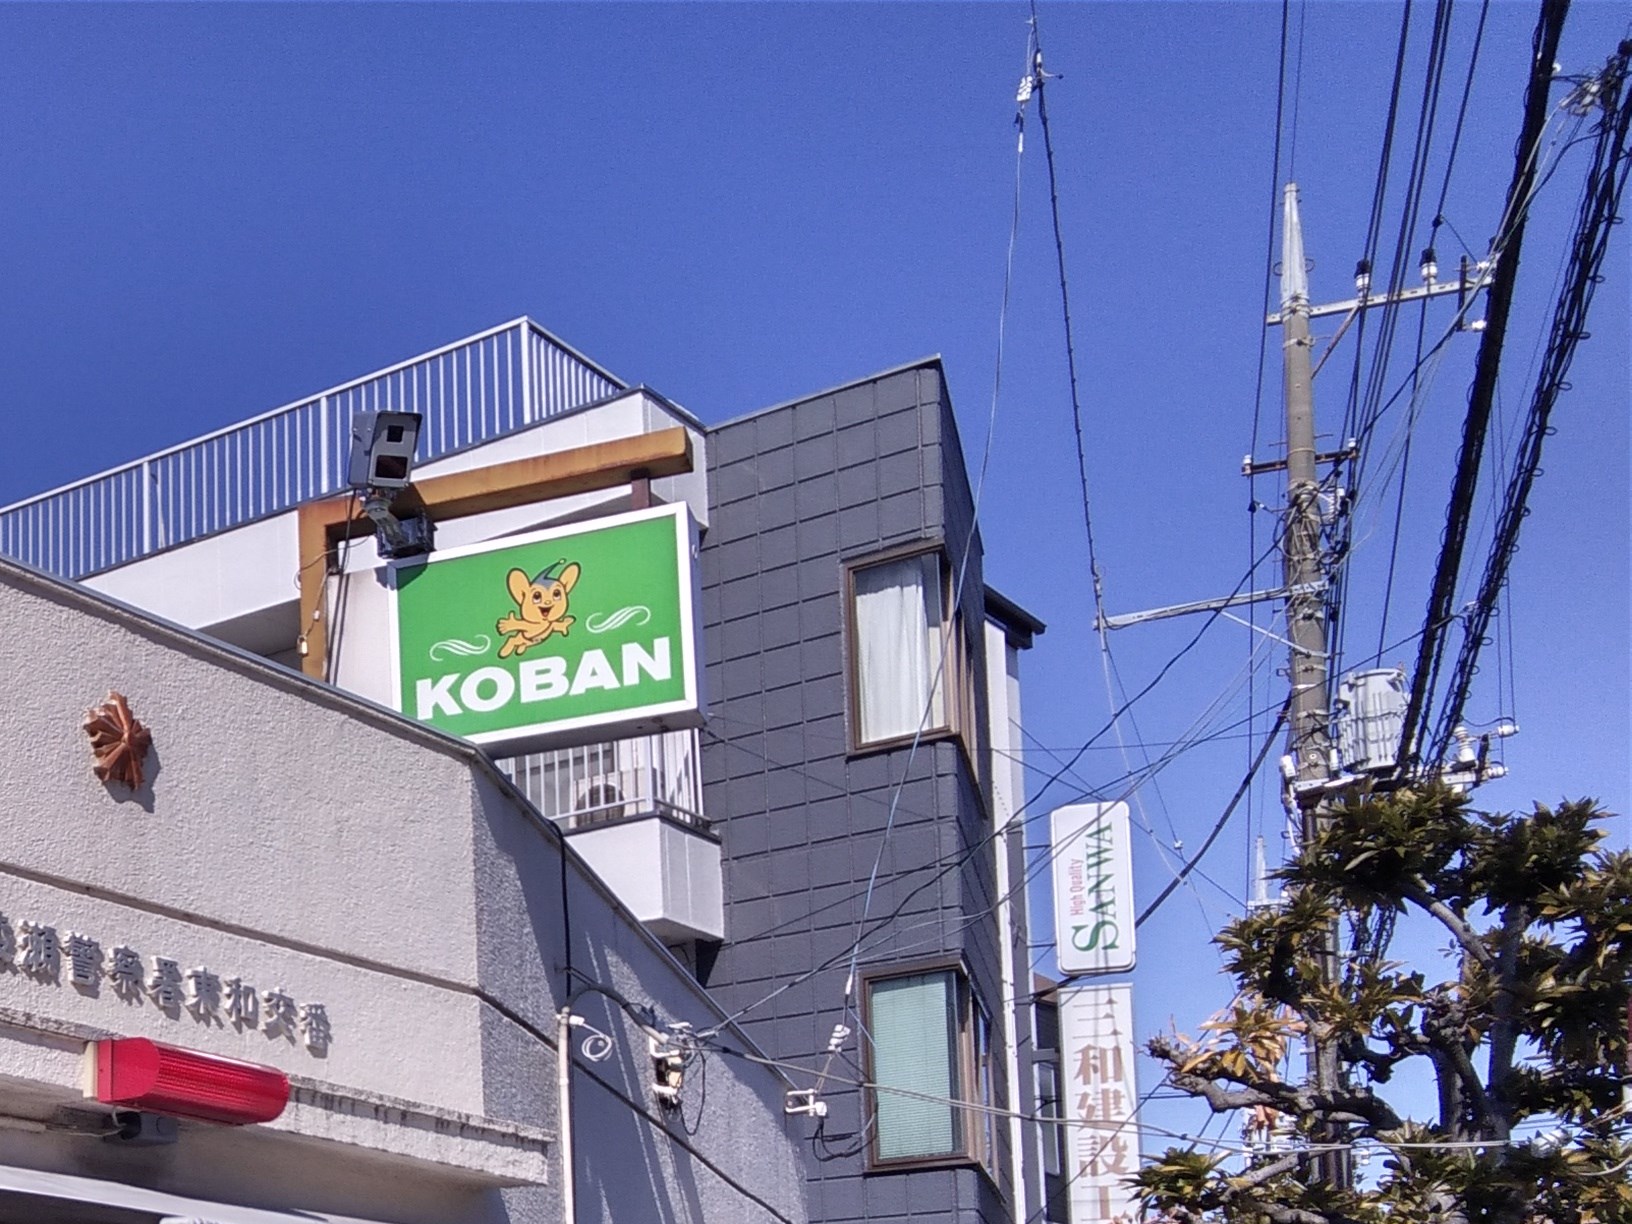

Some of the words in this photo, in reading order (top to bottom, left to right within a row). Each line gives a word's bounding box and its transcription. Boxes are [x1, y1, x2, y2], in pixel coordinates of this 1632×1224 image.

[415, 636, 672, 720] KOBAN
[1069, 858, 1085, 893] Quality
[1070, 893, 1086, 917] High
[1071, 821, 1120, 952] SANWA
